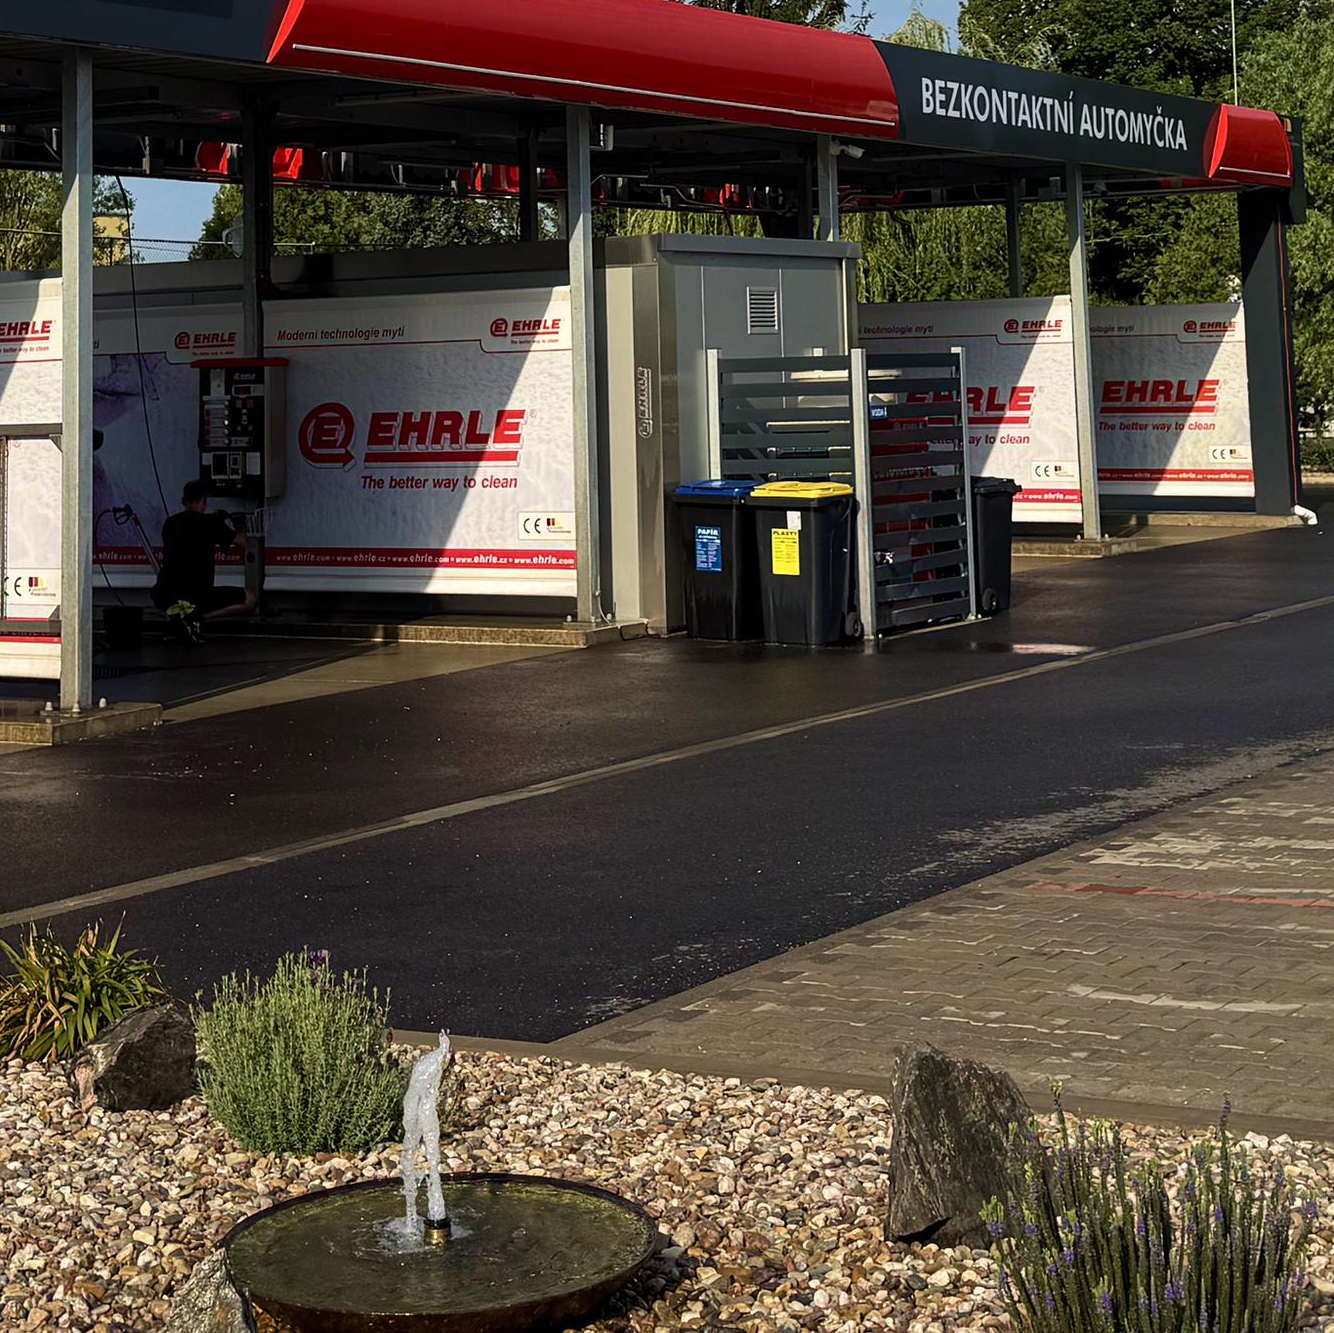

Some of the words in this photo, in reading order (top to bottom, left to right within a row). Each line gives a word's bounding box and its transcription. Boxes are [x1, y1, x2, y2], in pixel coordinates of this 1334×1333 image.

[921, 77, 1075, 135] BEZKONTAKTNÍ
[1079, 105, 1188, 151] AUTOMYČKA
[511, 318, 561, 332] EHRLE
[1021, 319, 1063, 329] EHRLE
[193, 331, 237, 344] EHRLE
[277, 328, 318, 341] Moderní
[320, 326, 380, 342] technologie
[382, 324, 405, 340] mytí
[1101, 379, 1220, 403] EHRLE
[367, 409, 527, 451] EHRLE
[1099, 422, 1116, 431] The
[1119, 421, 1148, 431] better
[1152, 422, 1172, 433] way
[1175, 421, 1185, 431] to
[1188, 421, 1216, 431] clean
[968, 436, 982, 446] ay
[985, 434, 996, 444] to
[1000, 434, 1030, 444] clean
[361, 475, 385, 490] The
[389, 475, 429, 490] better
[432, 478, 460, 493] way
[463, 476, 476, 490] to
[481, 475, 518, 489] clean
[392, 553, 450, 564] www.ehrle.com
[455, 553, 508, 564] www.ehrle.cz
[514, 554, 575, 565] www.ehrle.com
